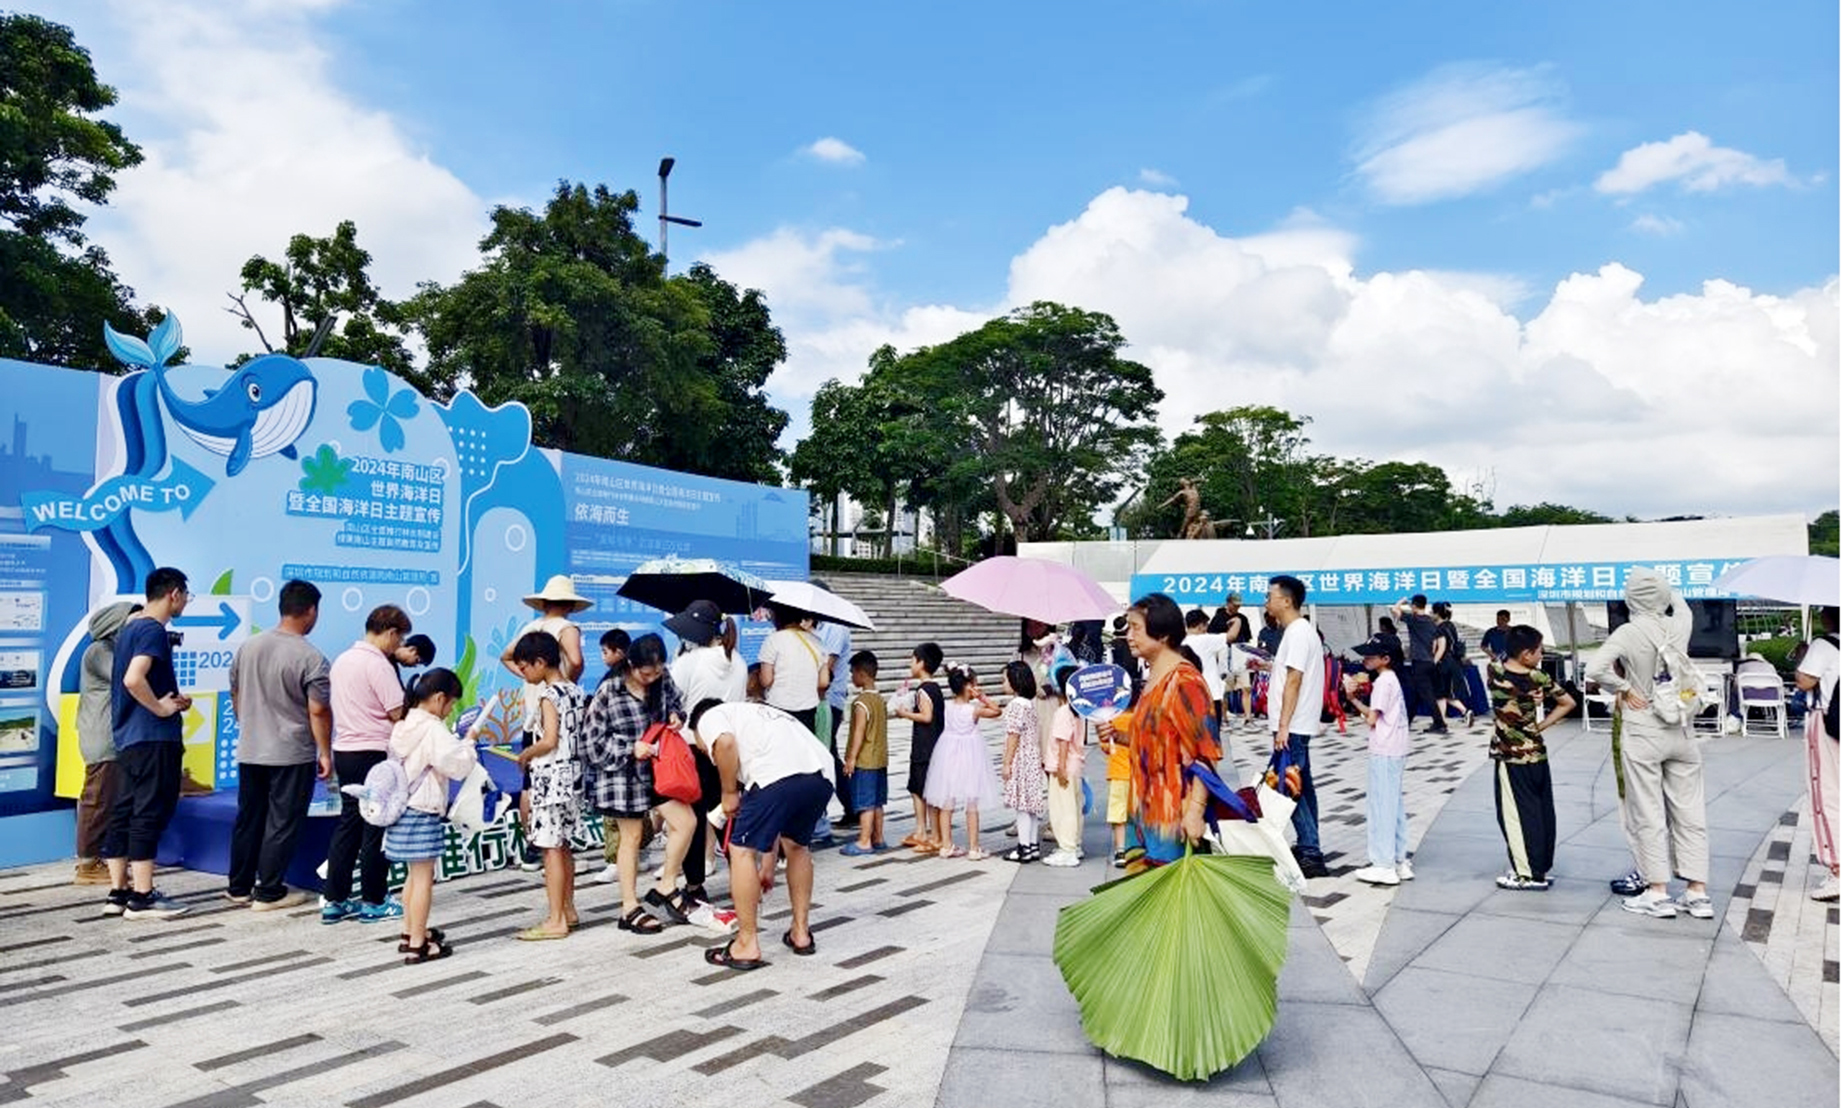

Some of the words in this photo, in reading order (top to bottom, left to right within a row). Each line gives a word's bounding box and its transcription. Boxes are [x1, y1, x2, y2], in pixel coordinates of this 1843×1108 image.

[351, 458, 443, 484] 2024年南山区
[33, 484, 154, 522] WELCOME
[161, 484, 190, 503] TO
[371, 481, 441, 504] 世界海洋日
[288, 492, 441, 523] 暨全国海洋日主题宣传
[575, 503, 629, 525] 依海而生
[1164, 562, 1741, 593] 2024年南区世界海洋日暨全国海洋日题宣
